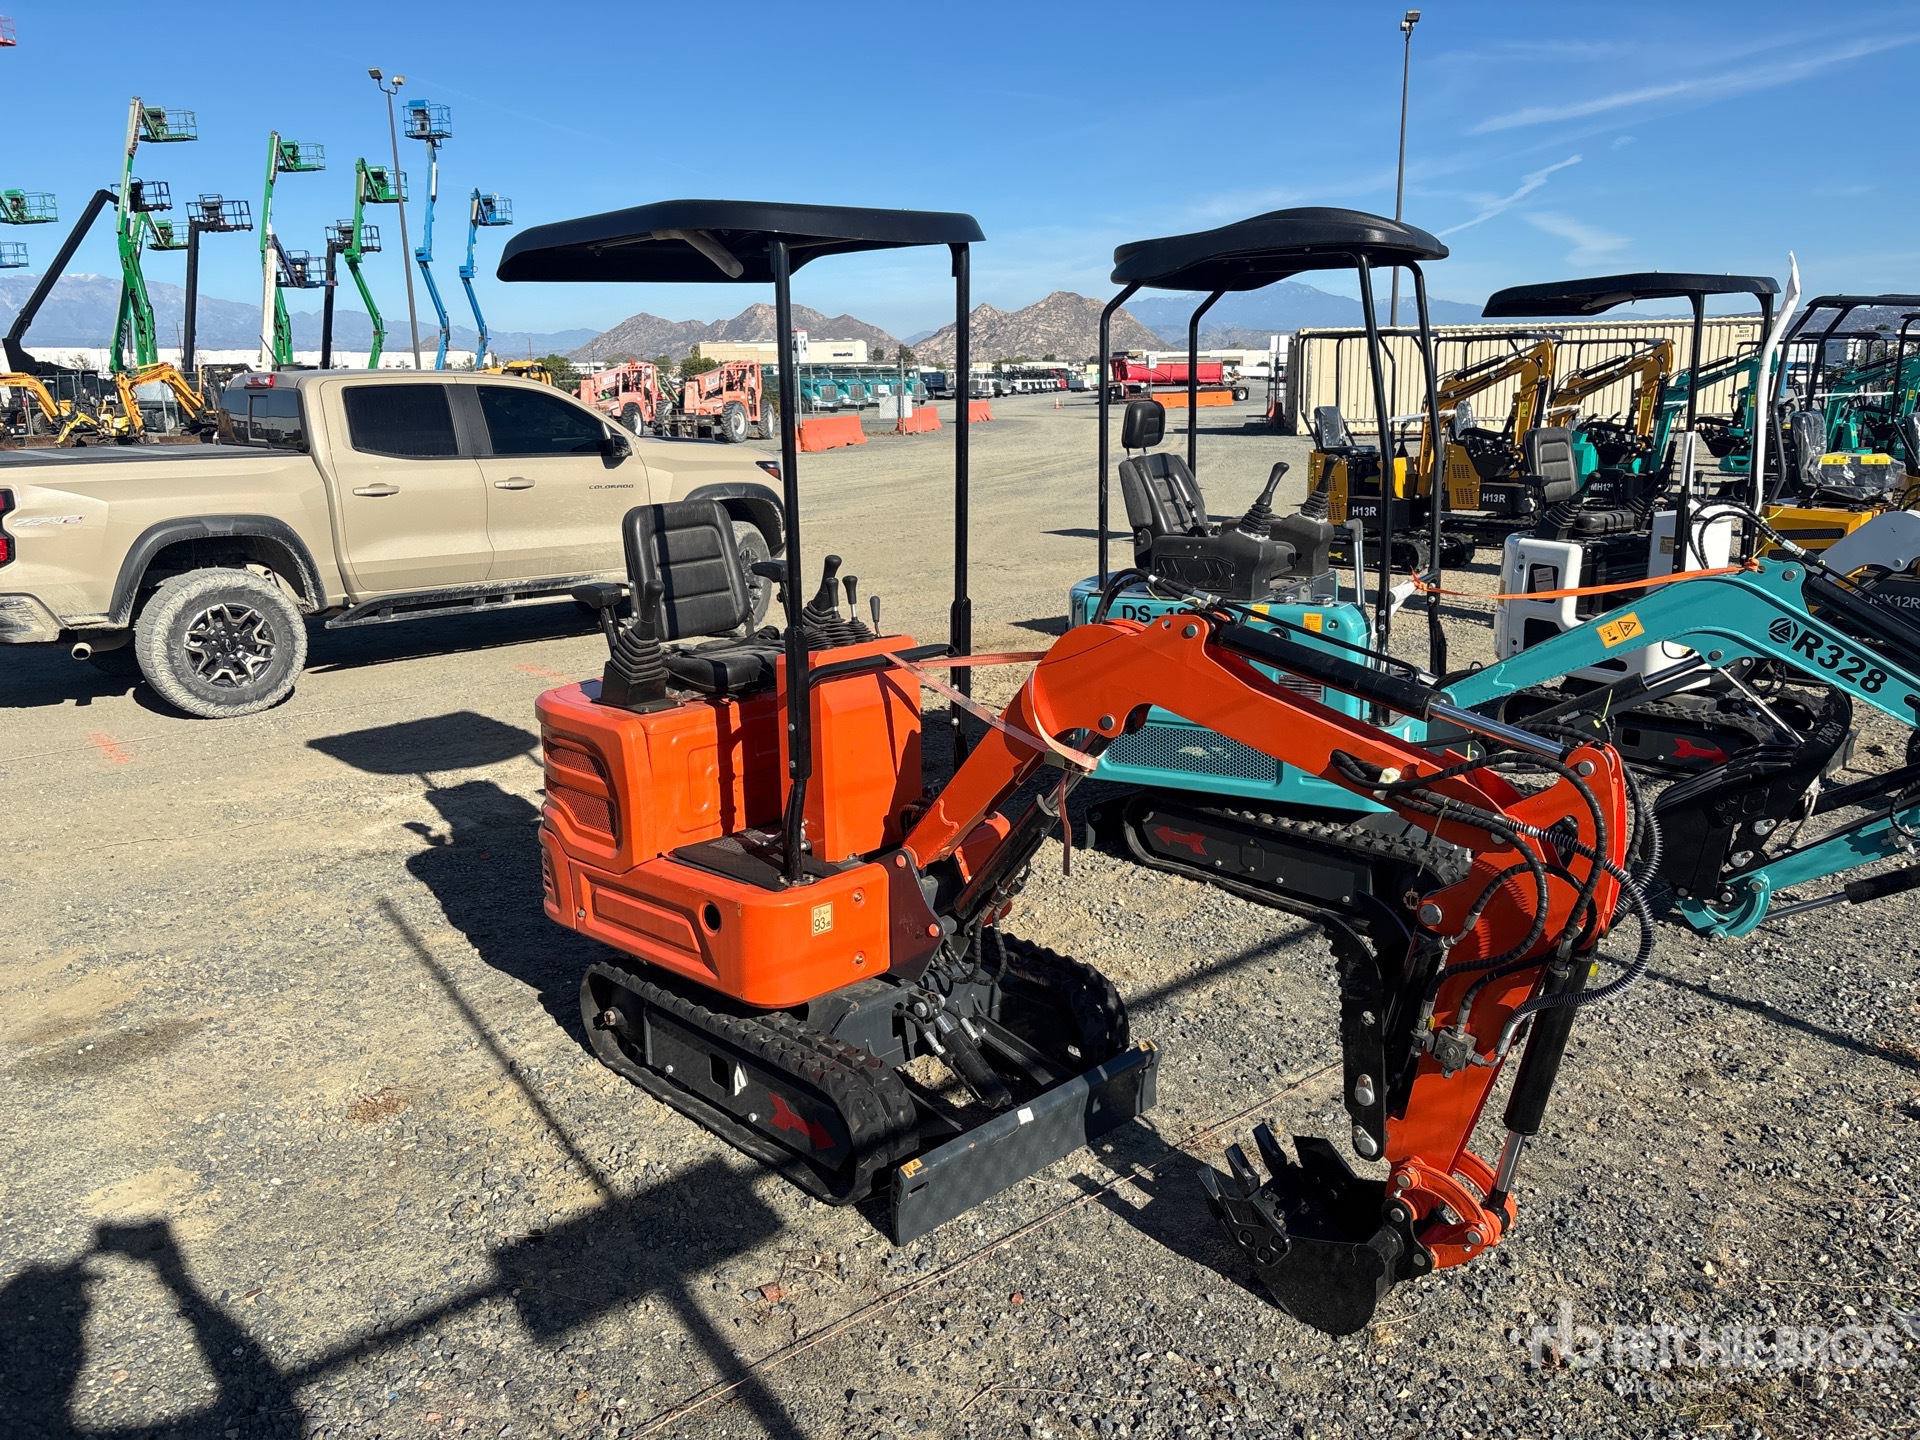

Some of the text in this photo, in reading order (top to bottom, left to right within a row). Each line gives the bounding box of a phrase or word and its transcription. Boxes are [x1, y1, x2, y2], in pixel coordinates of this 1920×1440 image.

[1482, 493, 1506, 504] H13R
[1352, 505, 1377, 517] H13R
[1791, 629, 1888, 694] R328
[814, 916, 826, 932] 93
